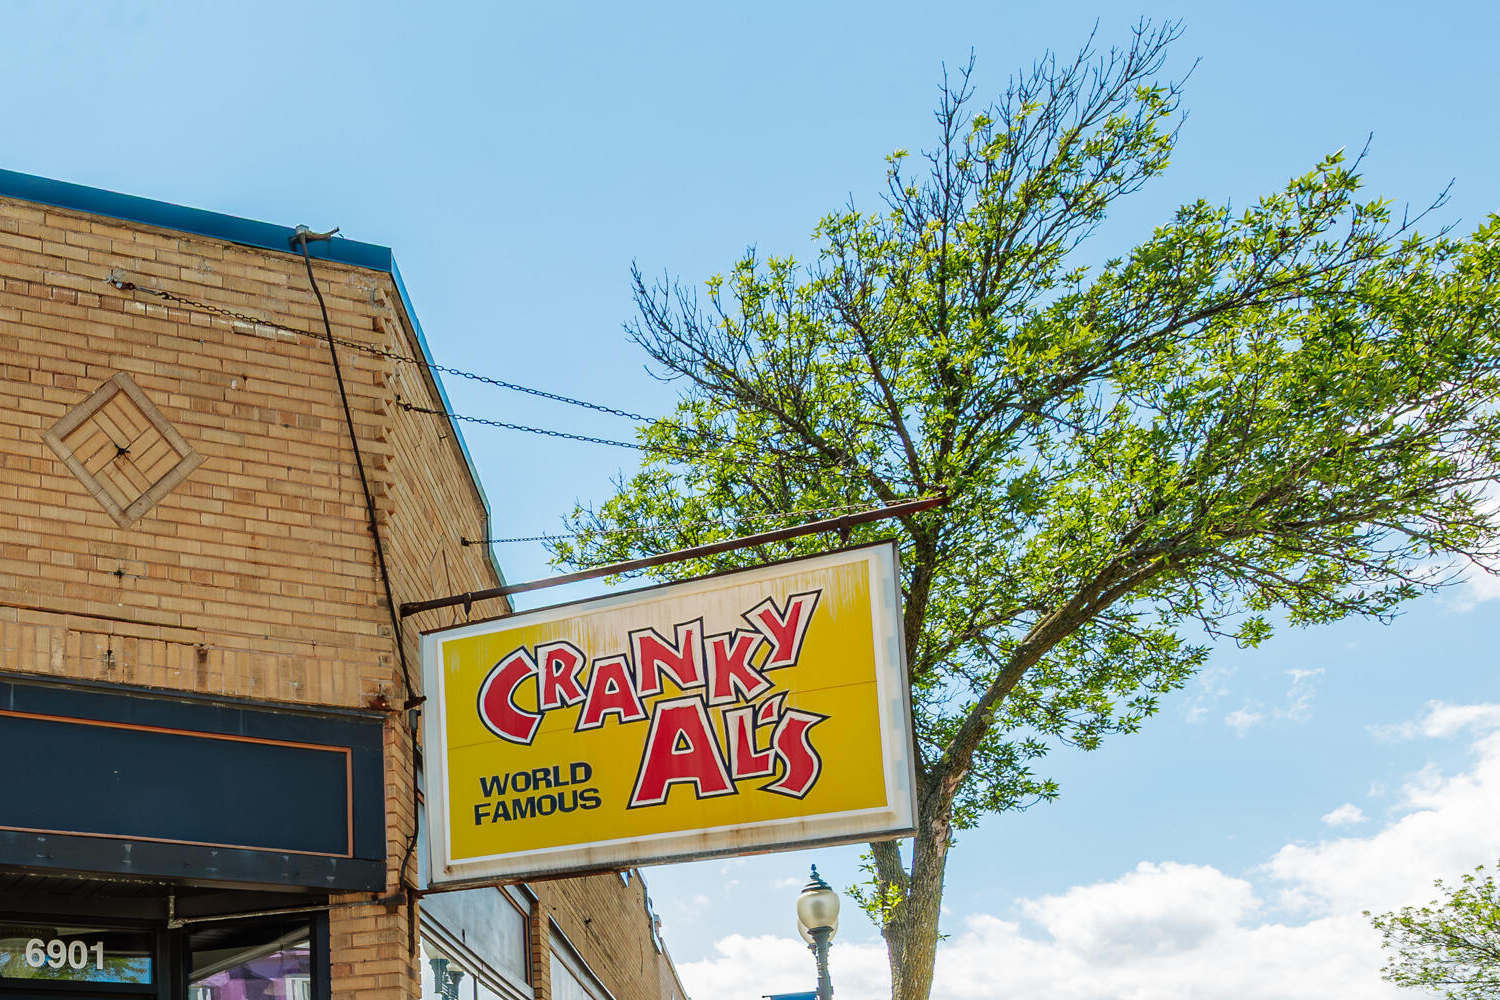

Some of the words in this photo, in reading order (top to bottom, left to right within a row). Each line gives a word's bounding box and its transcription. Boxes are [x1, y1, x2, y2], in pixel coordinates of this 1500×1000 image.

[477, 588, 823, 746] CRANKY
[626, 690, 831, 810] AL'S
[480, 761, 593, 798] WORLD
[474, 788, 602, 825] FAMOUS
[25, 938, 104, 970] 6901
